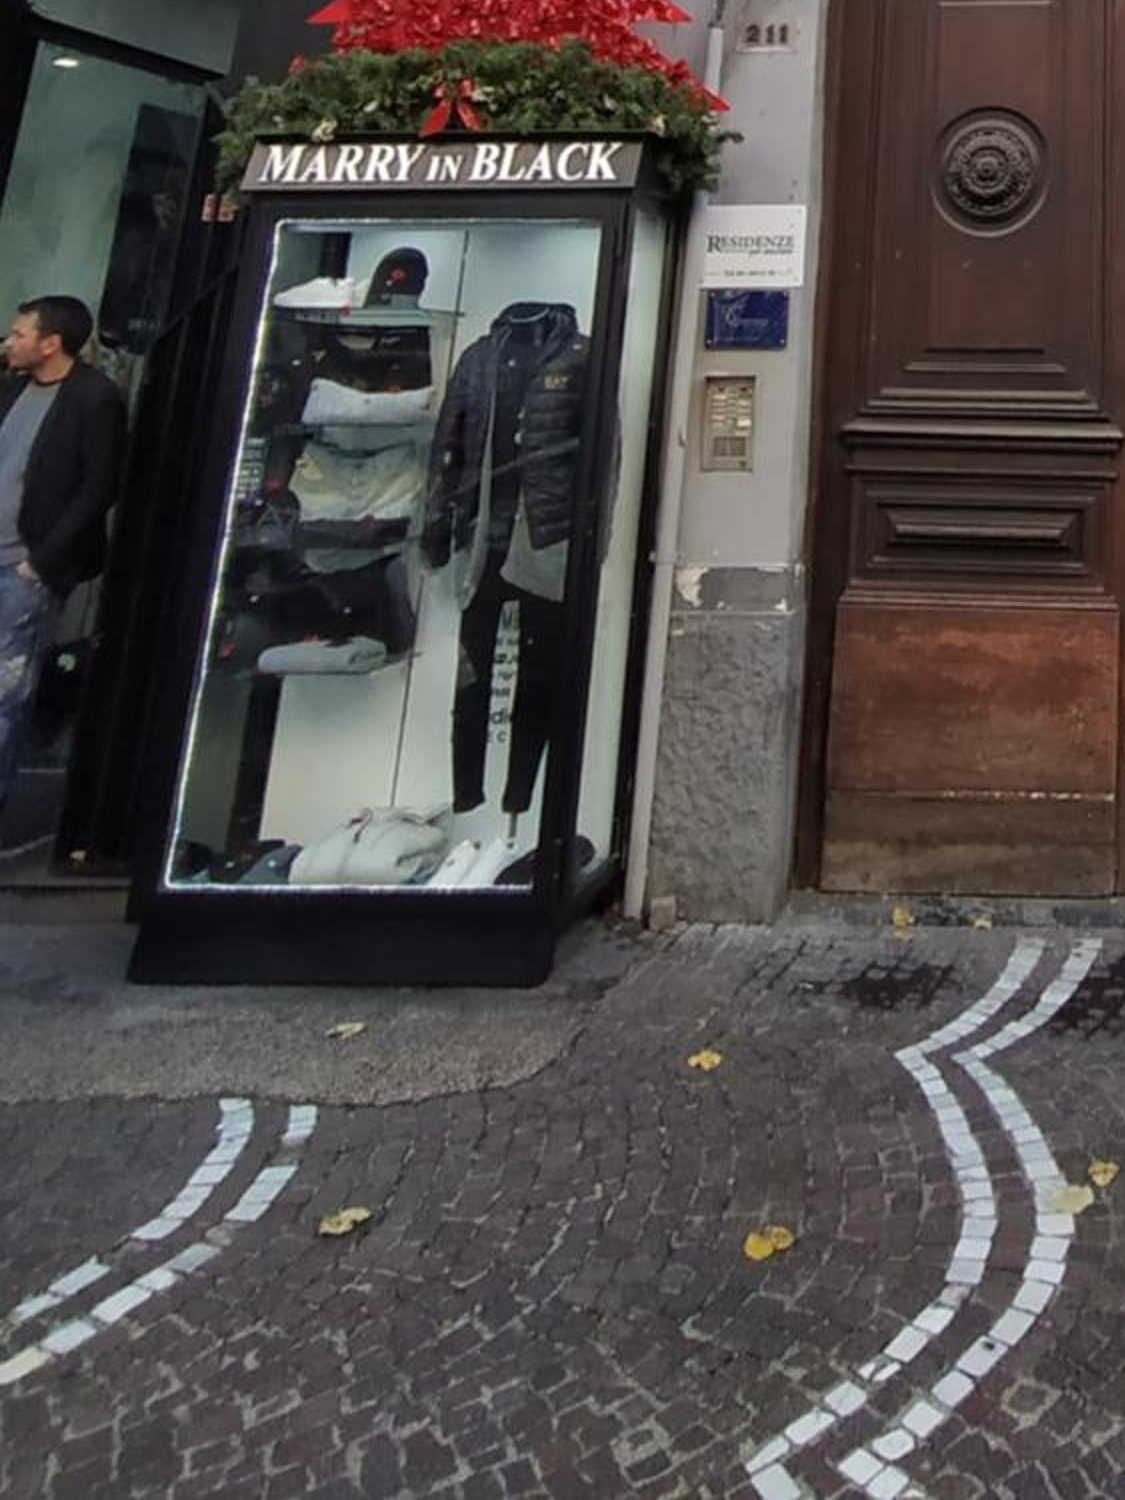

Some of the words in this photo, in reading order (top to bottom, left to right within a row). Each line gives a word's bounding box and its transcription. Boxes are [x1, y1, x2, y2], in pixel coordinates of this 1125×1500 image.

[744, 23, 788, 45] 211
[258, 143, 426, 183] MARRY
[426, 155, 463, 181] IN
[468, 142, 622, 181] BLACK
